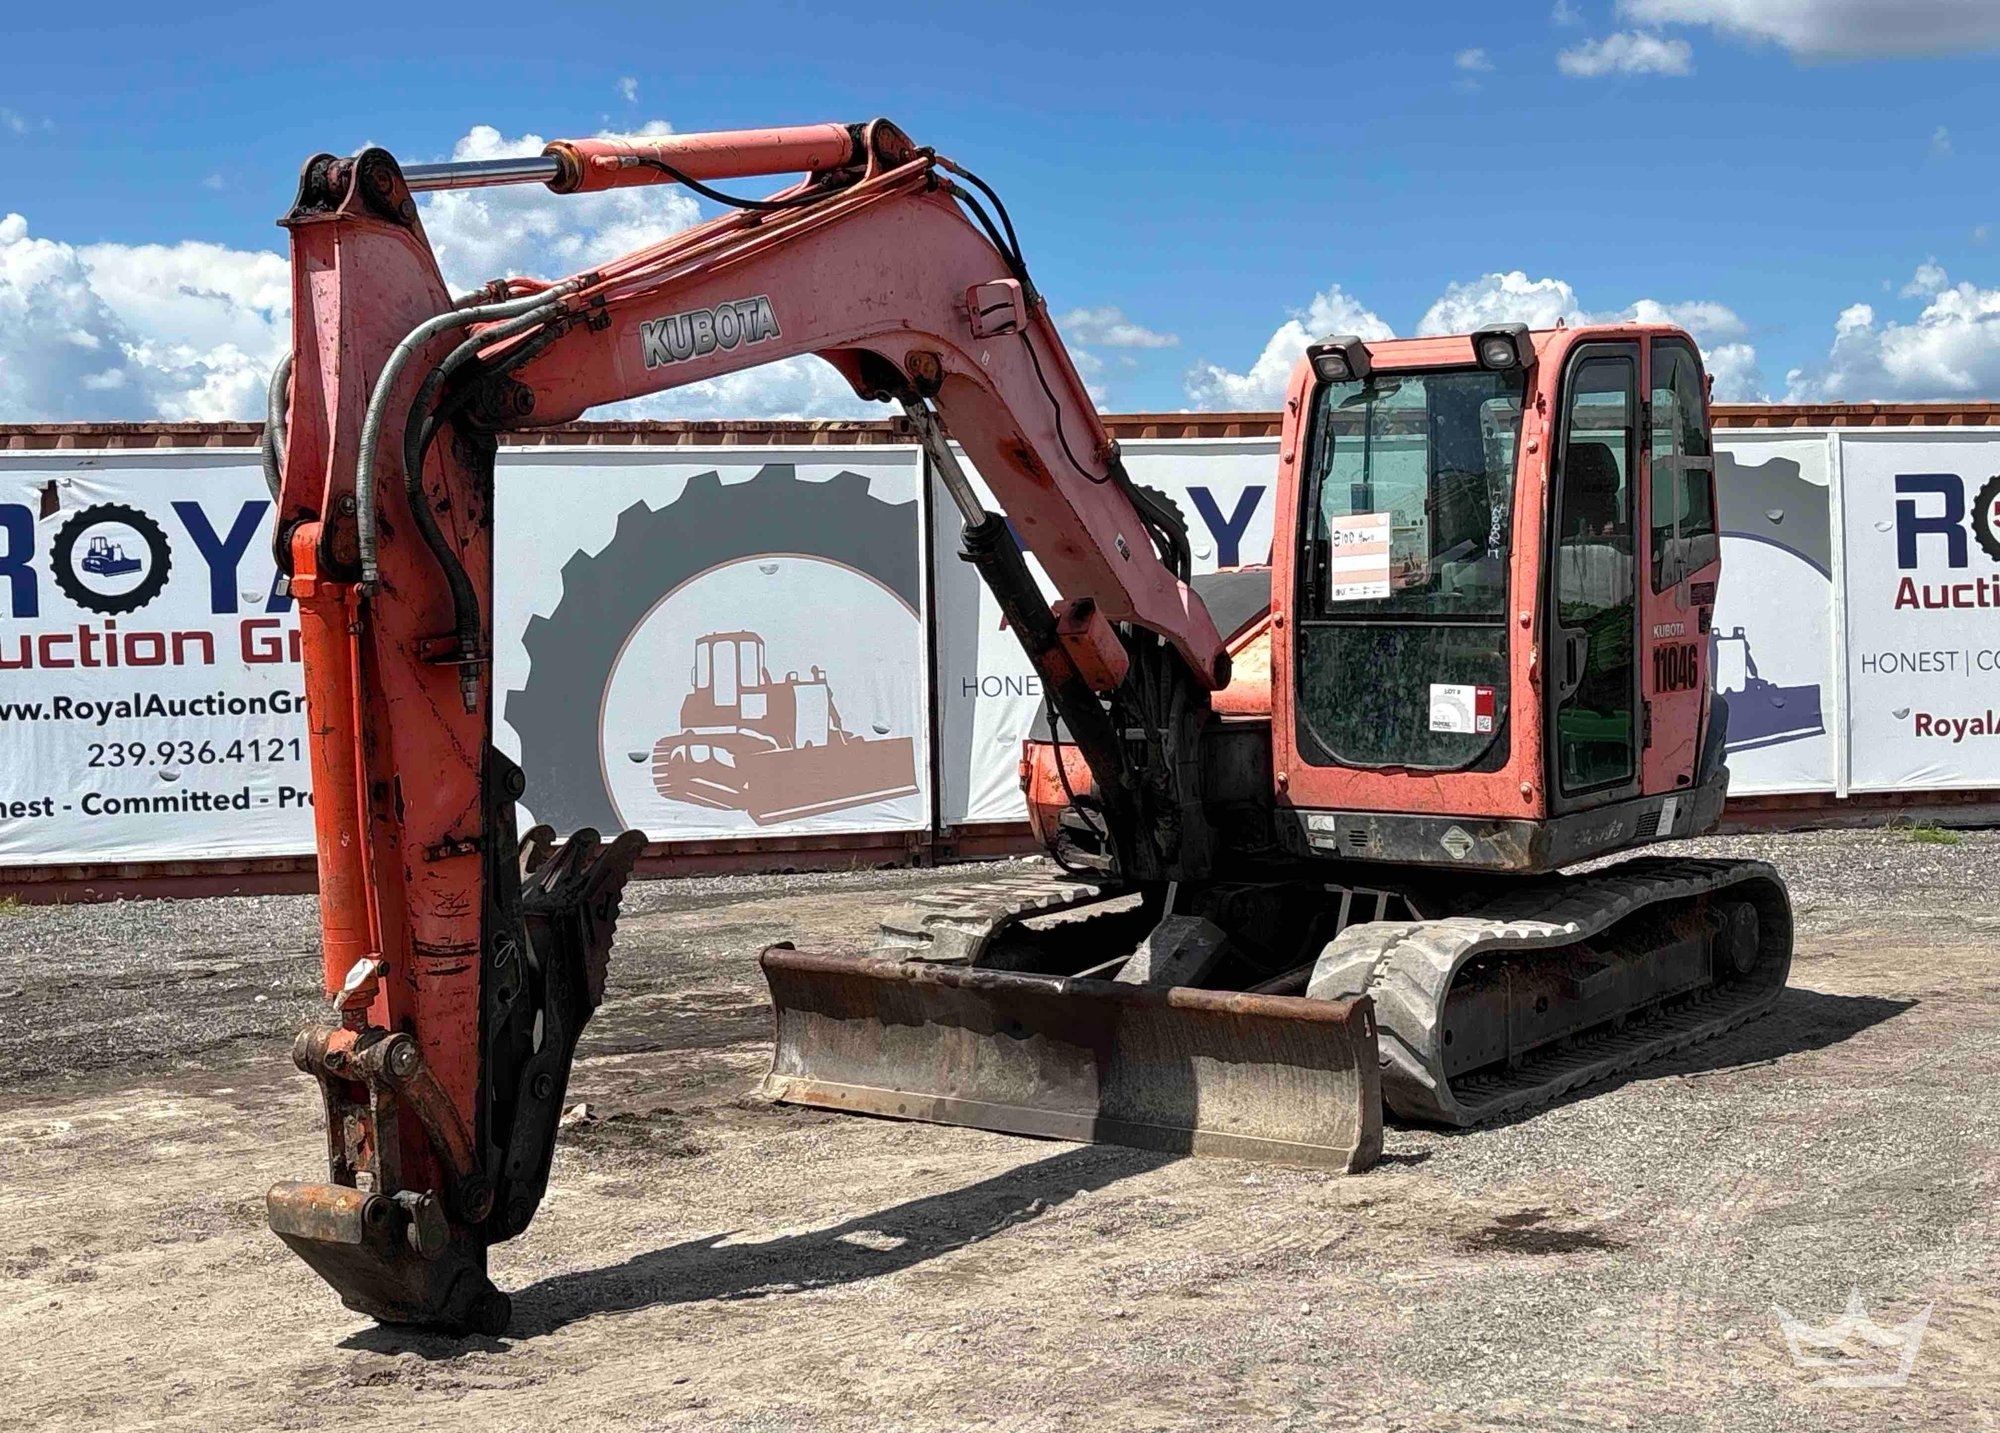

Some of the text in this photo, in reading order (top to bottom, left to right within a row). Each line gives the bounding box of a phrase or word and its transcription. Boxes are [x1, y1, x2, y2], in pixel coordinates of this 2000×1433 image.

[641, 296, 781, 368] KUBOTA
[1653, 623, 1686, 639] KUBOTA
[1653, 644, 1698, 693] 11046
[1861, 651, 1960, 674] HONEST
[962, 675, 1044, 697] HONE
[87, 737, 301, 769] 239.936.4121
[81, 786, 250, 816] Committed
